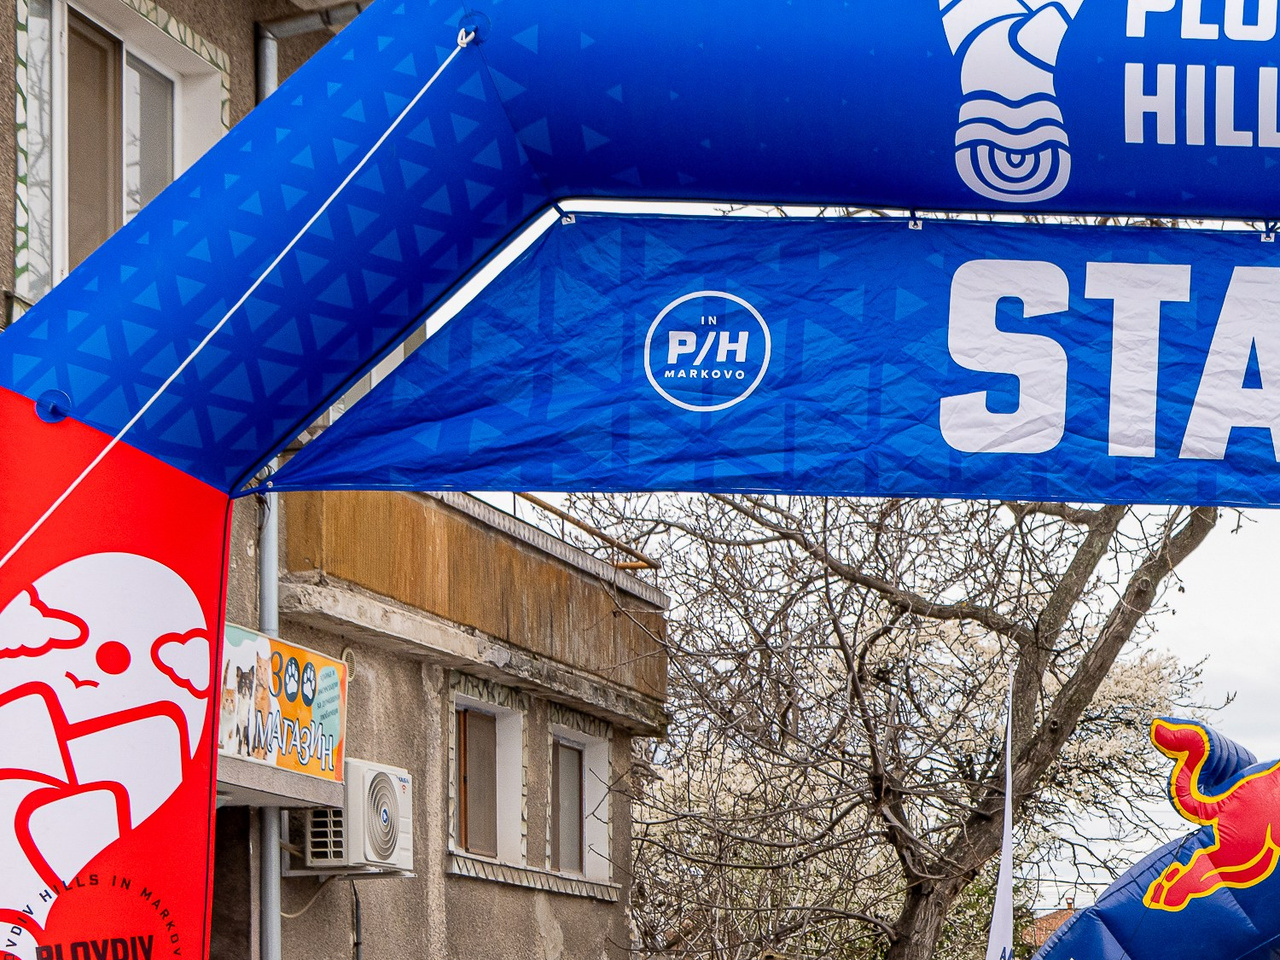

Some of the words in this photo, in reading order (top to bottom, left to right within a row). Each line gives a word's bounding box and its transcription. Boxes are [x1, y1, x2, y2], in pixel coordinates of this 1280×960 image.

[701, 315, 717, 326] IN
[667, 330, 749, 366] P/H
[664, 369, 745, 380] MARKOVO
[254, 709, 335, 772] МАГАЗИН
[39, 873, 100, 903] HILLS
[112, 874, 132, 890] IN
